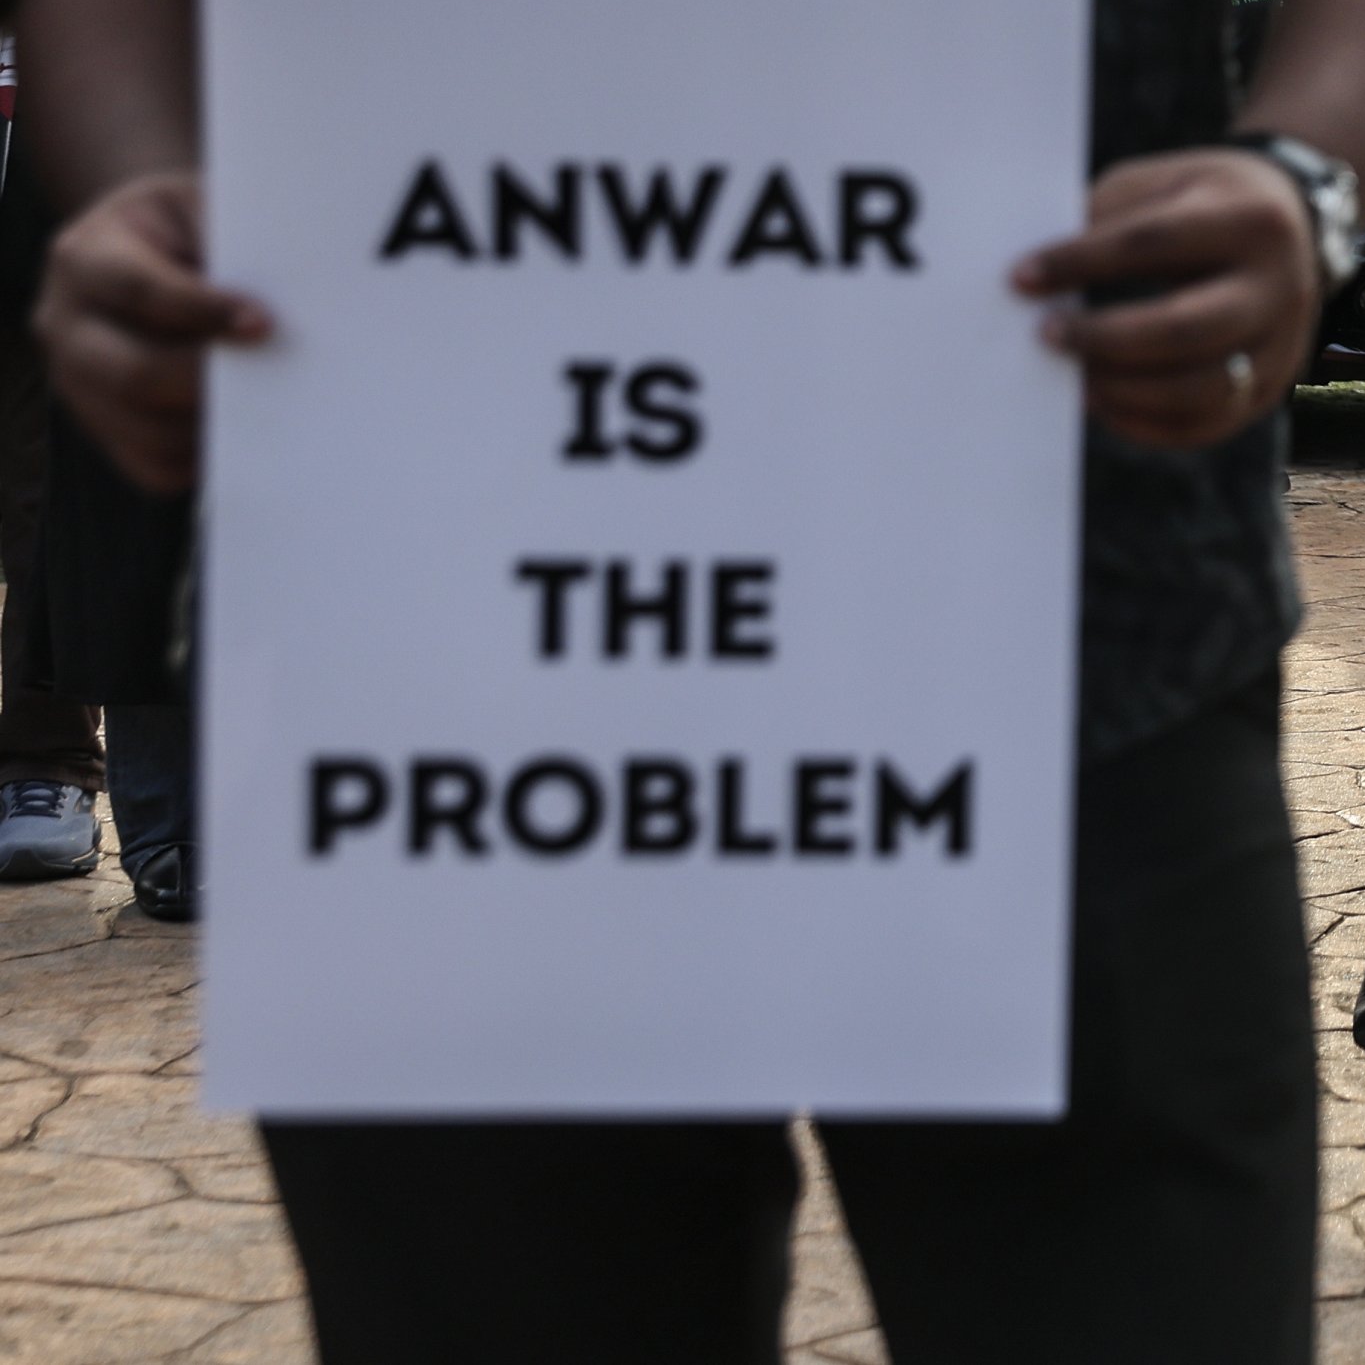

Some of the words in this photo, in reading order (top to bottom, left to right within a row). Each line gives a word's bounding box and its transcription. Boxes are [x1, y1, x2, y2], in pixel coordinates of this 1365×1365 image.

[379, 158, 923, 270] ANWAR
[561, 360, 706, 464] IS
[514, 557, 777, 662] THE
[306, 753, 975, 860] PROBLEM
